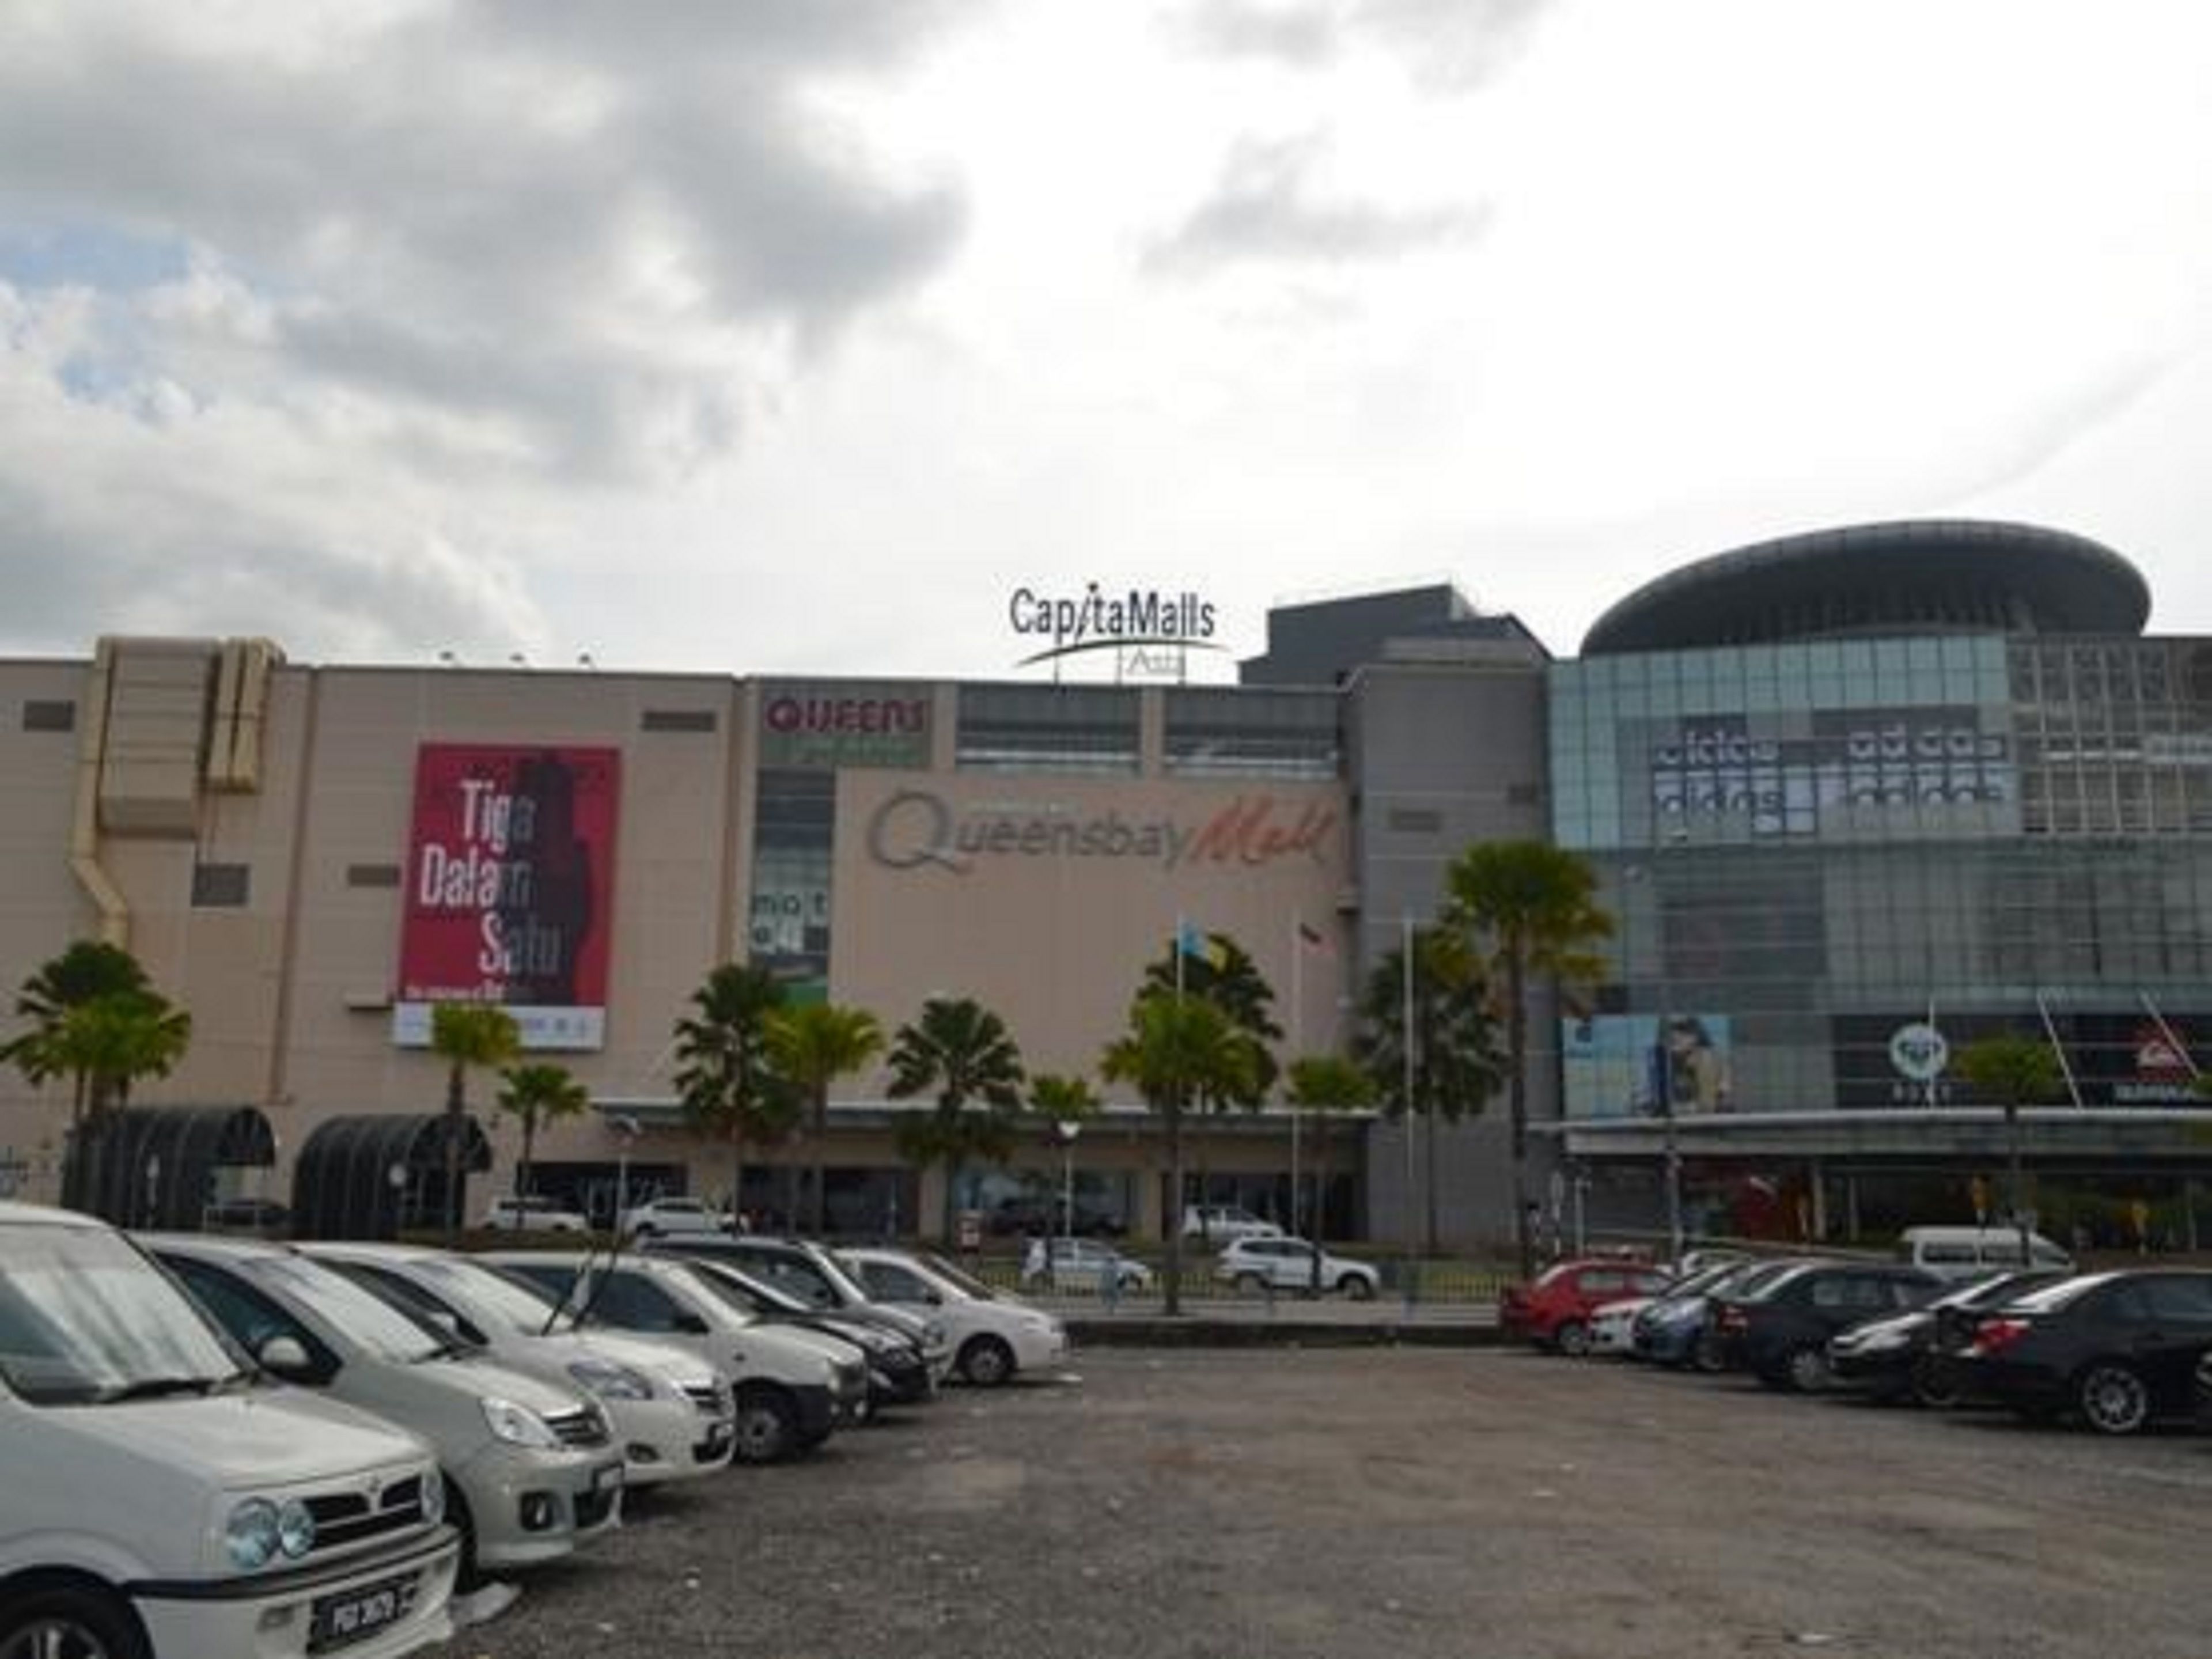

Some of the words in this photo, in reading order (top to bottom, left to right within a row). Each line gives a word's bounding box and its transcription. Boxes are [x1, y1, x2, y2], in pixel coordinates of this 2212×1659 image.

[1010, 581, 1216, 645] CapitaMalls
[461, 780, 536, 852] Tiga
[869, 790, 1188, 874] Queensbay
[1189, 795, 1335, 866] Mall
[478, 911, 562, 975] Satu
